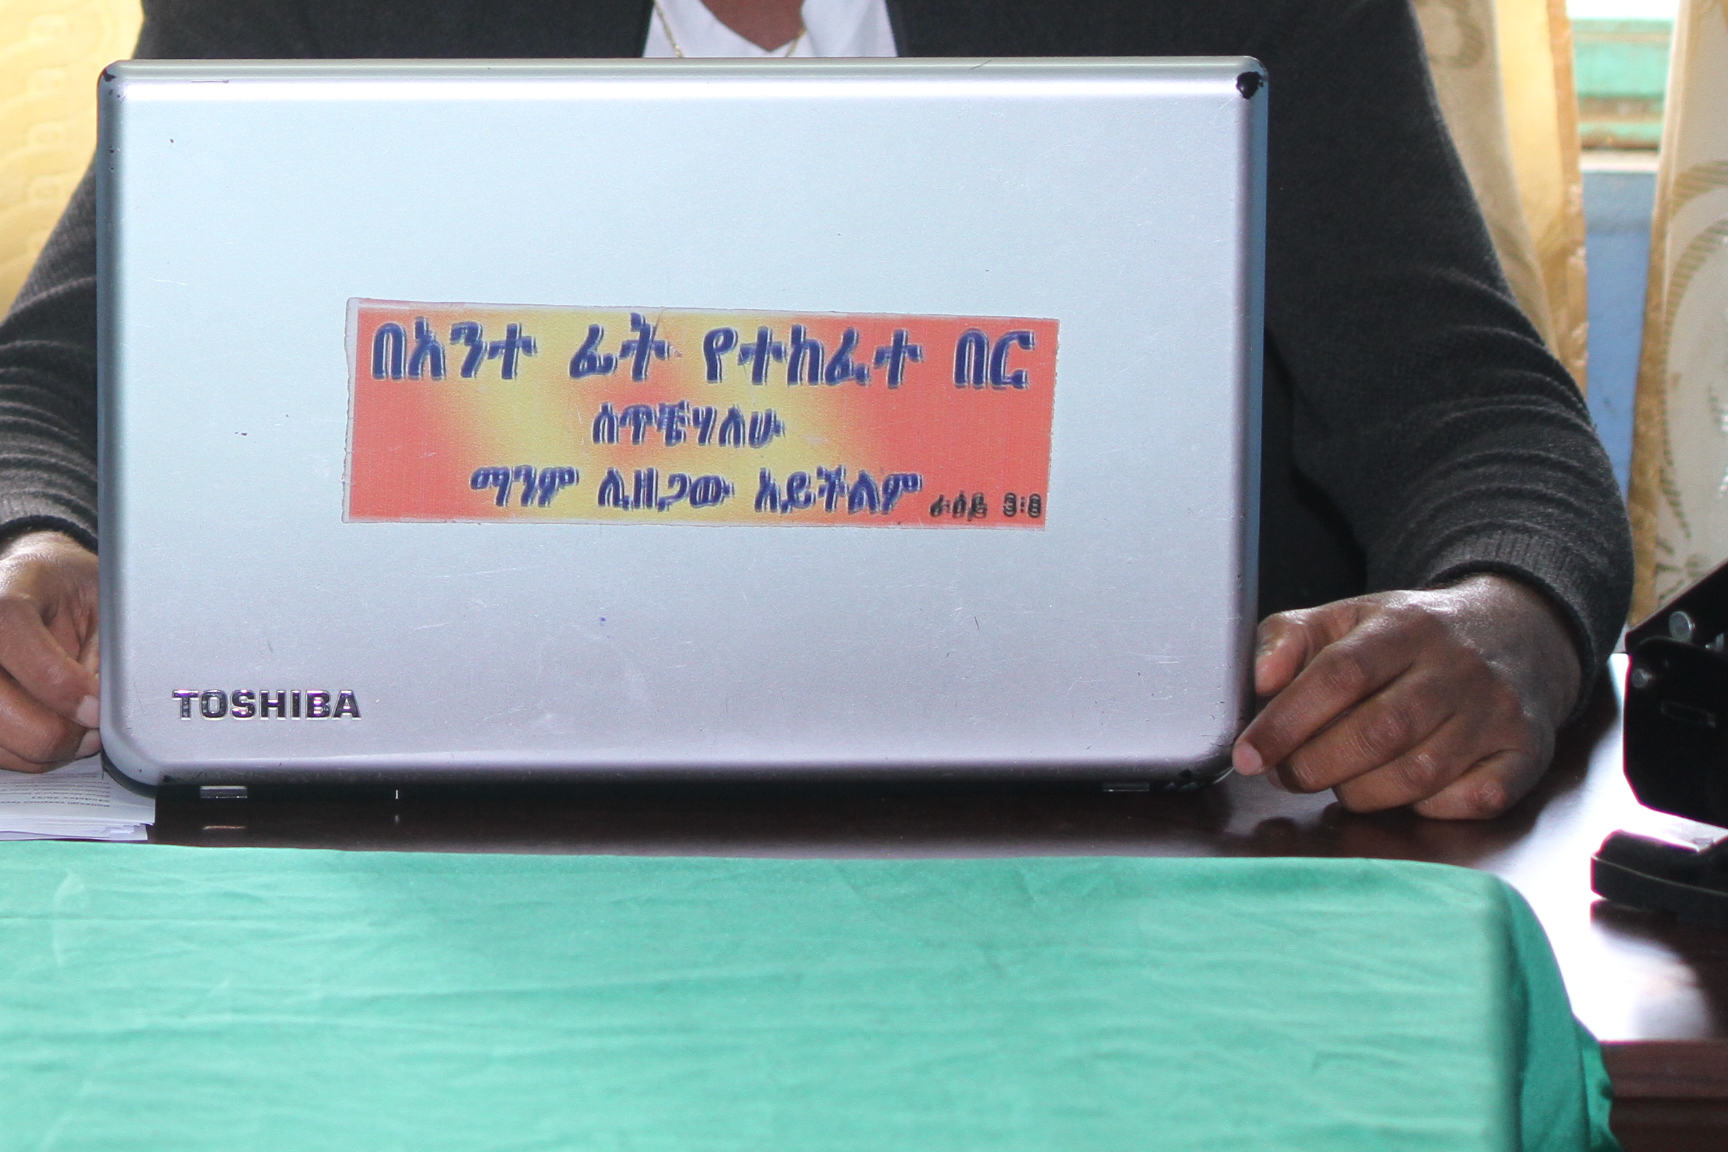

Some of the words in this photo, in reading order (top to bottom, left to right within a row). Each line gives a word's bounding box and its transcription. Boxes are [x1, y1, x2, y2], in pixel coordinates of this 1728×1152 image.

[371, 315, 538, 381] በአንተ
[568, 311, 671, 382] ፊት
[702, 323, 924, 389] የተከፈተ
[952, 327, 1037, 391] በር
[470, 464, 580, 509] ማንም
[597, 466, 735, 513] ሊዘጋው
[754, 464, 924, 515] አይችልም
[171, 688, 362, 721] TOSHIBA
